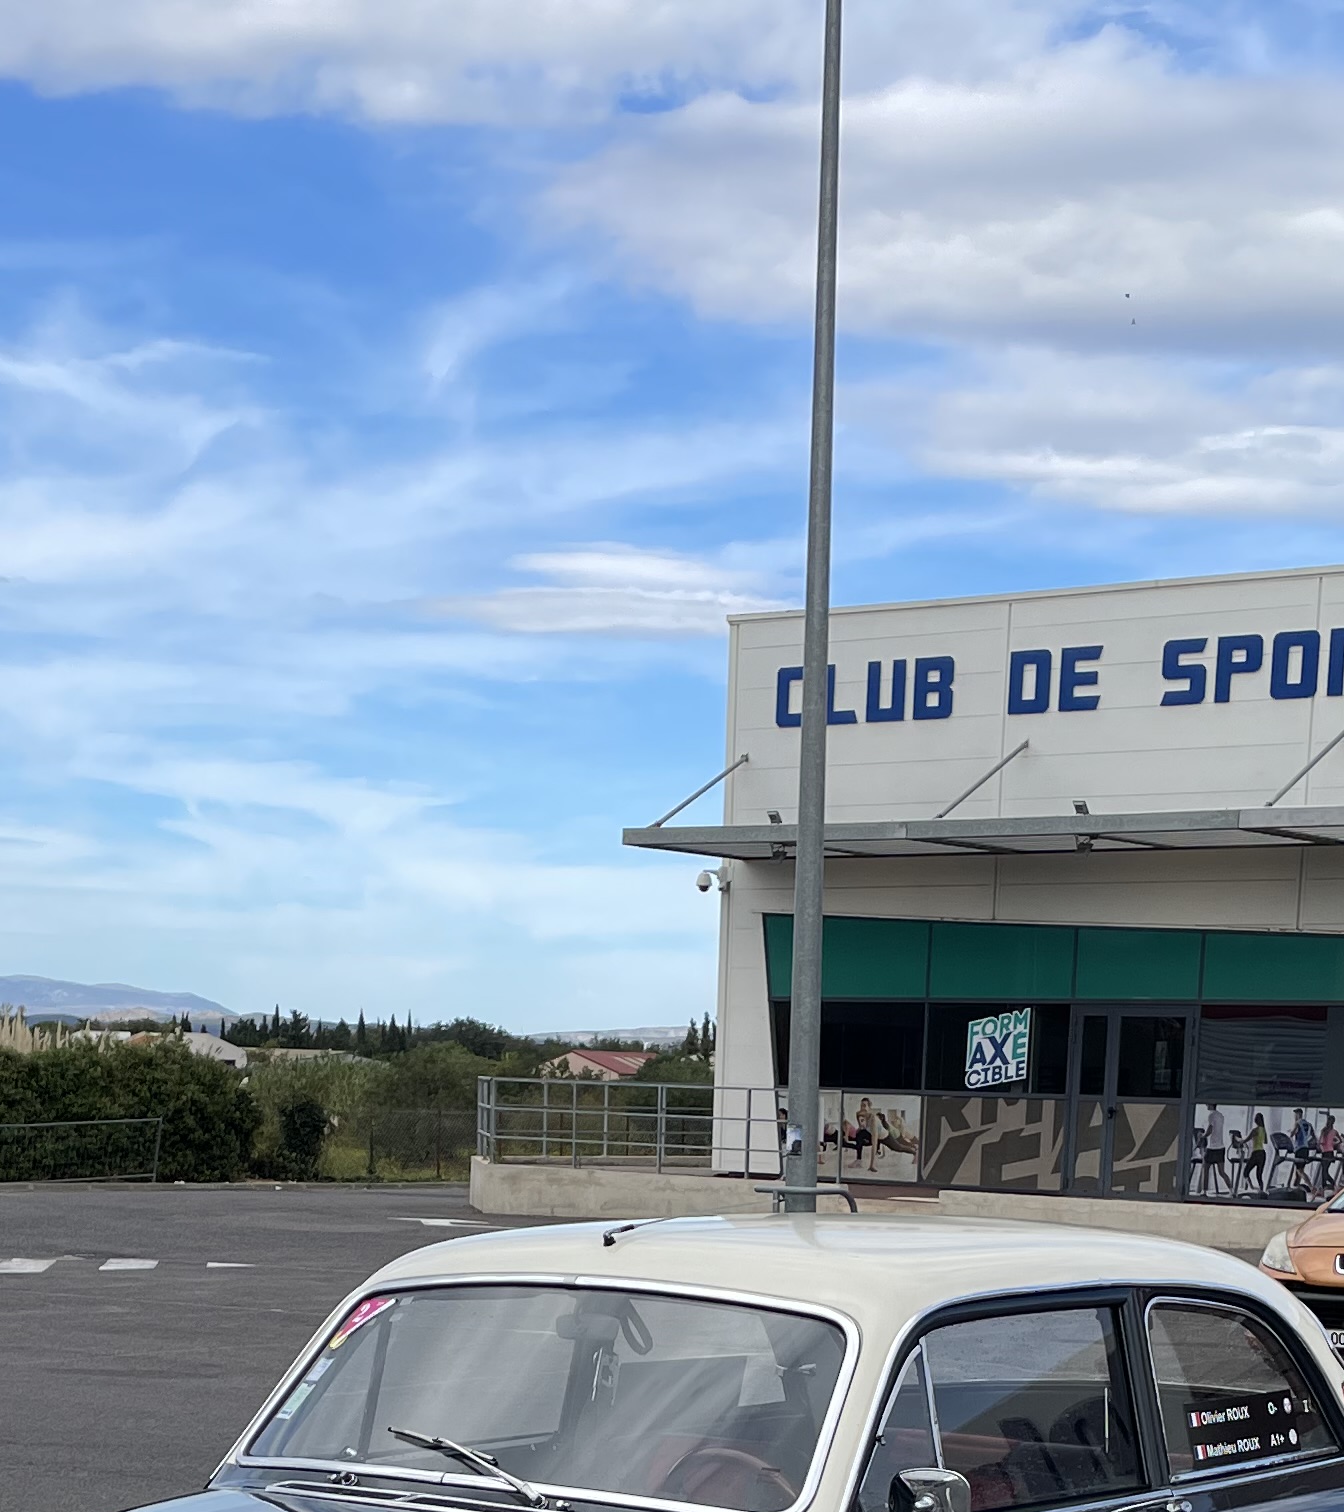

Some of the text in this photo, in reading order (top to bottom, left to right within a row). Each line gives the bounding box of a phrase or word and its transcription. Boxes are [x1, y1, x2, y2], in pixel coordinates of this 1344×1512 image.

[776, 655, 955, 728] CLUB
[1008, 645, 1104, 715] DE
[968, 1009, 1029, 1058] FORM
[967, 1060, 1026, 1087] CIBLE
[1200, 1409, 1226, 1425] Olivier
[1226, 1405, 1250, 1422] ROUX
[1206, 1441, 1237, 1458] Mathieu
[1237, 1437, 1261, 1453] ROUX
